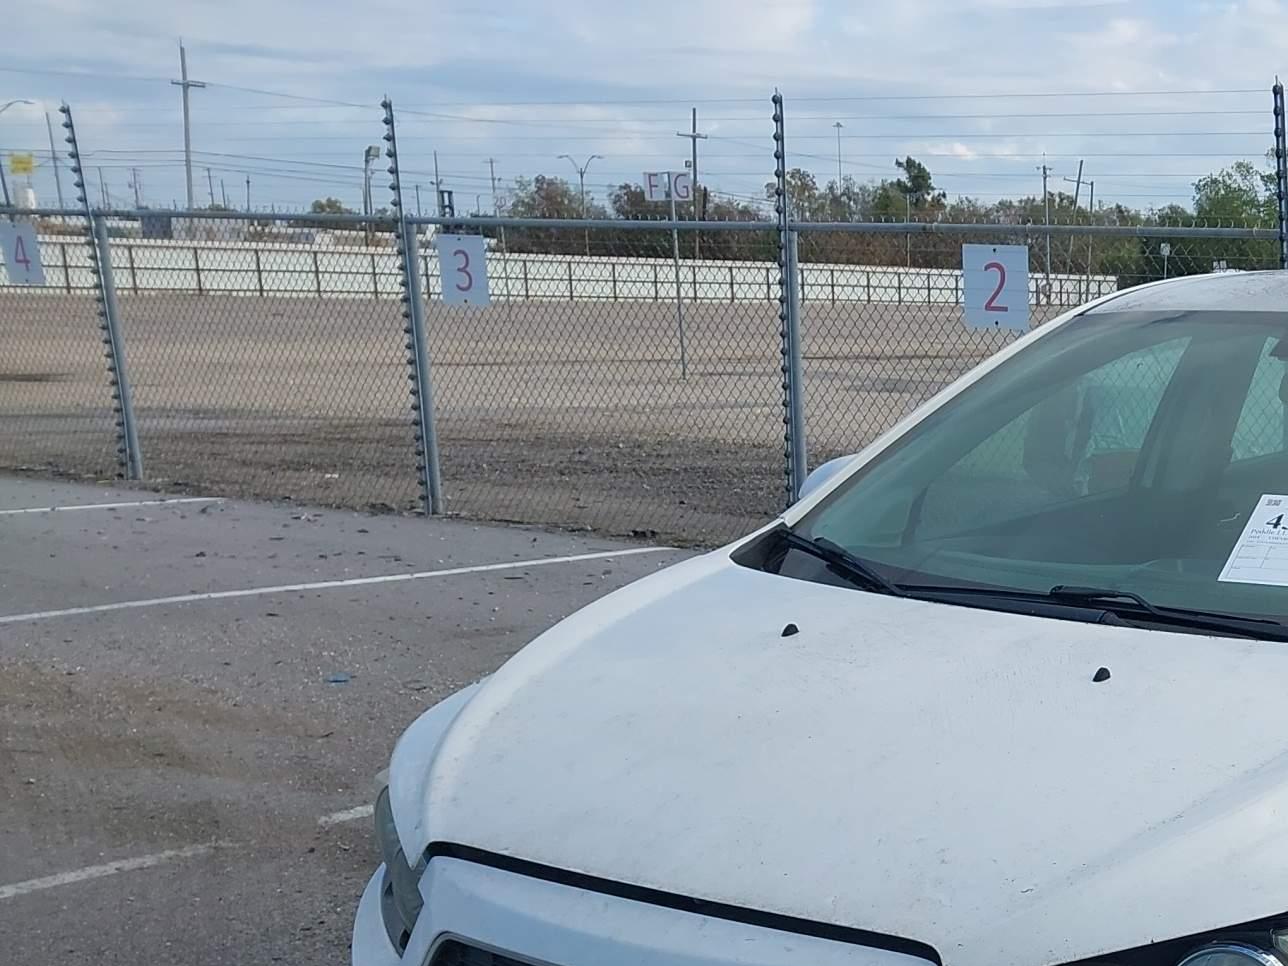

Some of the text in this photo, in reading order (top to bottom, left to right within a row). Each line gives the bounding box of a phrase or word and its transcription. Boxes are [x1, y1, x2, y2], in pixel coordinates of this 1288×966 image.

[648, 173, 658, 199] F
[674, 173, 689, 199] G
[15, 235, 31, 272] 4
[453, 249, 473, 292] 3
[984, 262, 1009, 312] 2
